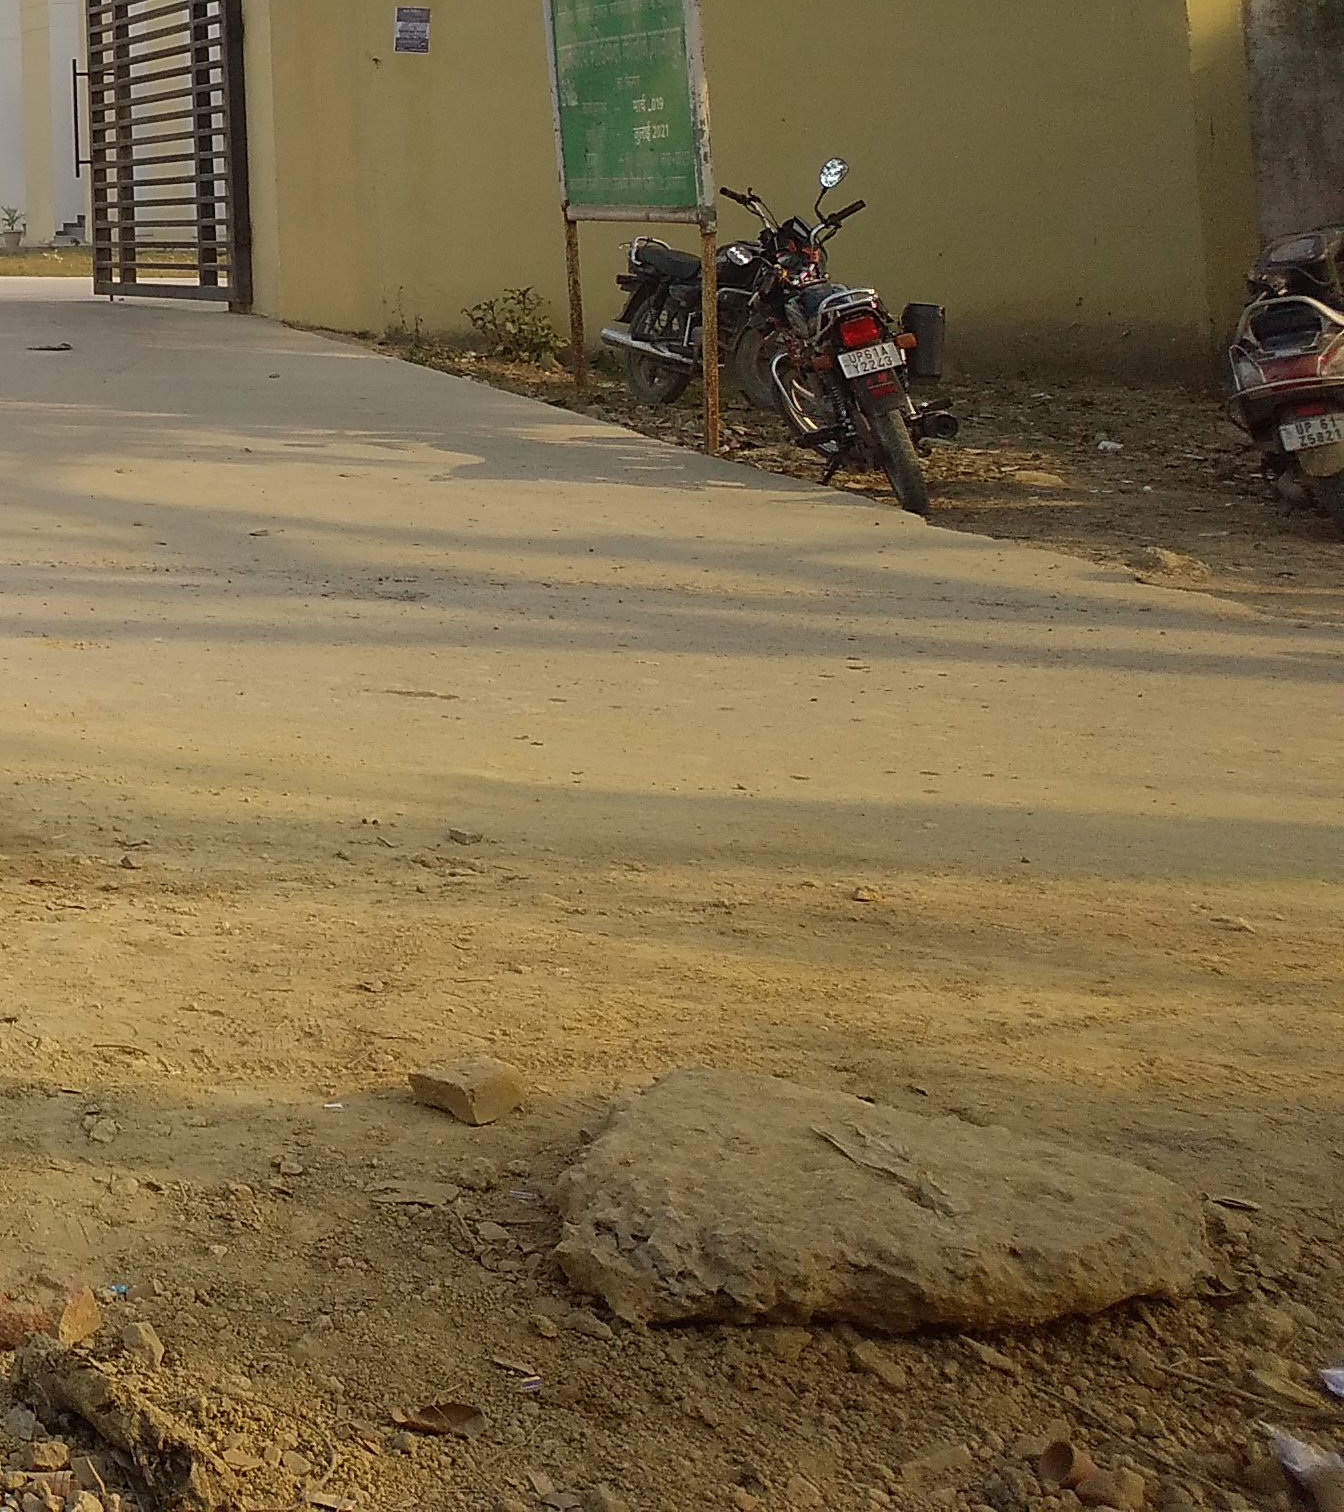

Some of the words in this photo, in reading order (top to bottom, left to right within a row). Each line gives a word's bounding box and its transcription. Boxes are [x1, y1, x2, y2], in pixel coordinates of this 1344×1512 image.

[652, 124, 669, 139] 2021
[848, 345, 889, 364] UP61A
[852, 355, 893, 374] Y2243
[1295, 421, 1312, 435] UP
